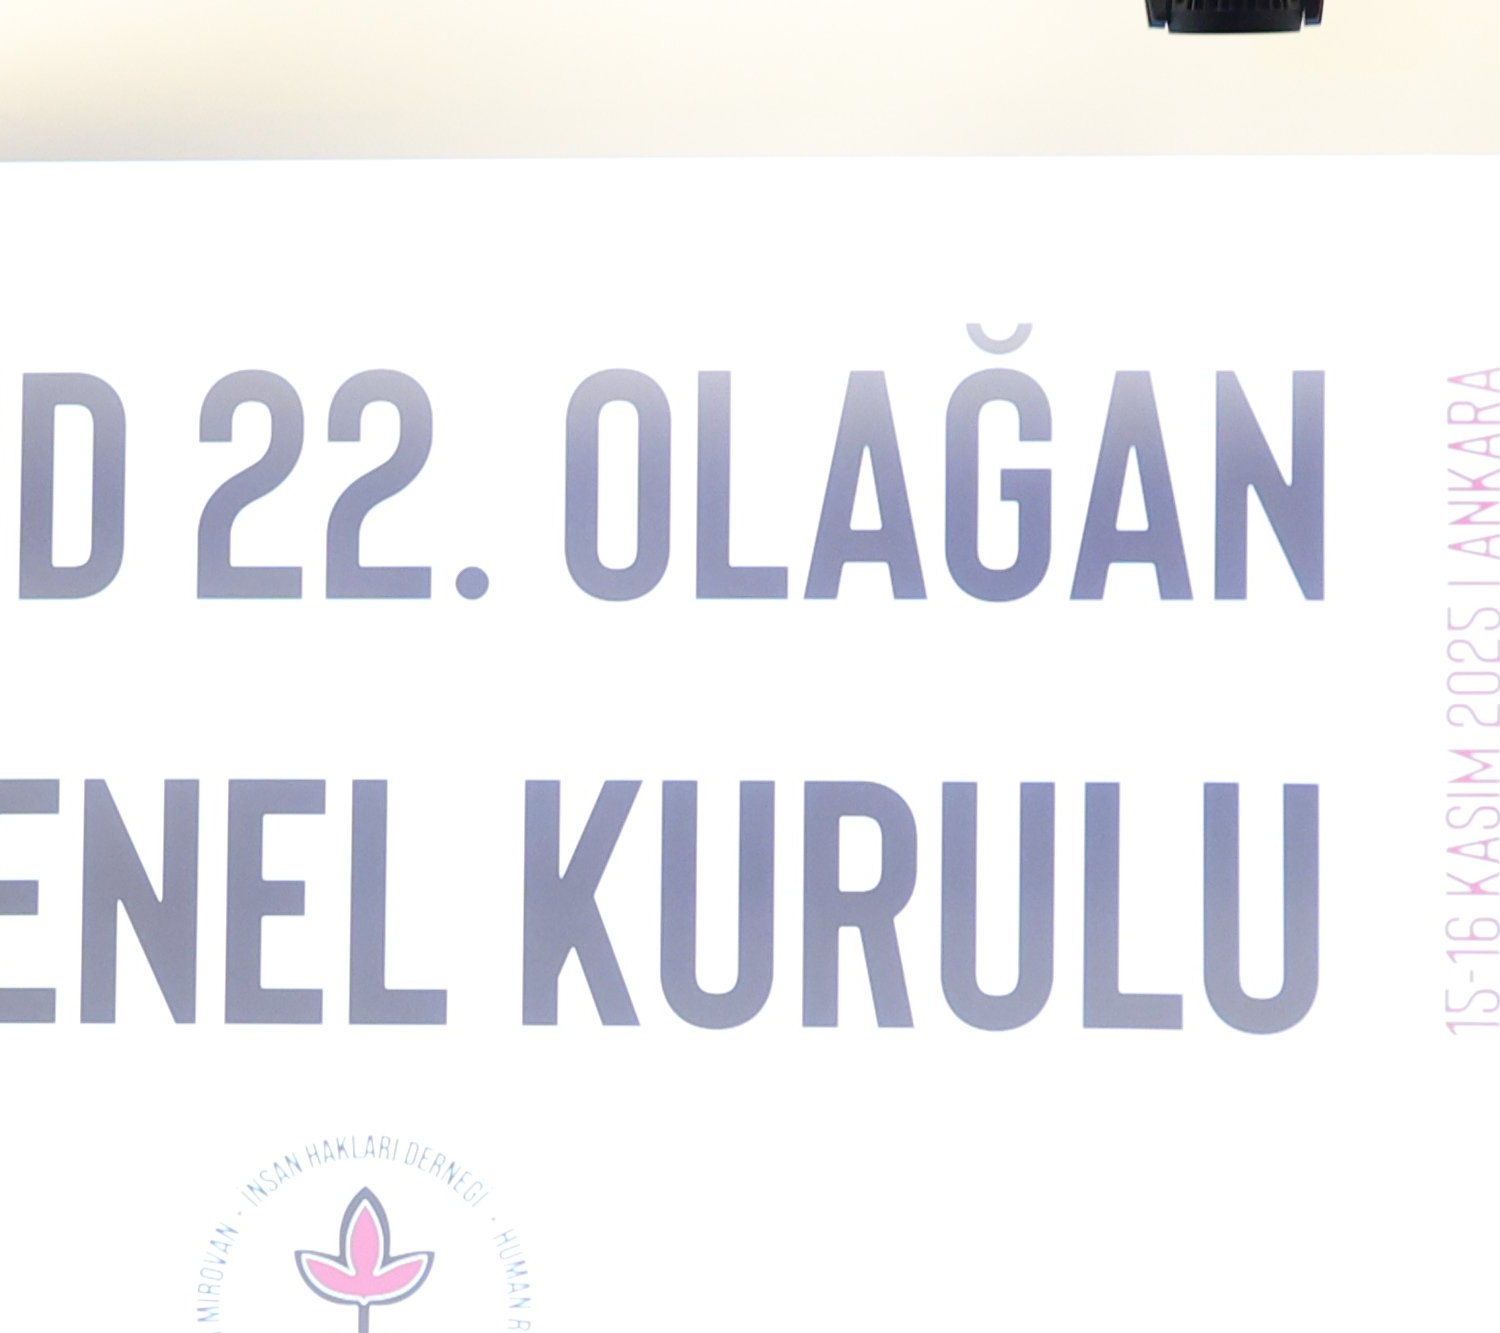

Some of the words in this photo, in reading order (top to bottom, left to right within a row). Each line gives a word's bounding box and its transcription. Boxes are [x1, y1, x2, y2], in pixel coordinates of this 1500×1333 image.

[196, 368, 490, 601] 22.
[565, 322, 1327, 603] OLAĞAN
[521, 779, 1321, 1036] KURULU
[304, 1134, 400, 1169] HAKLARI
[196, 1222, 240, 1323] MIROVAN
[493, 1228, 533, 1310] HUMAN
